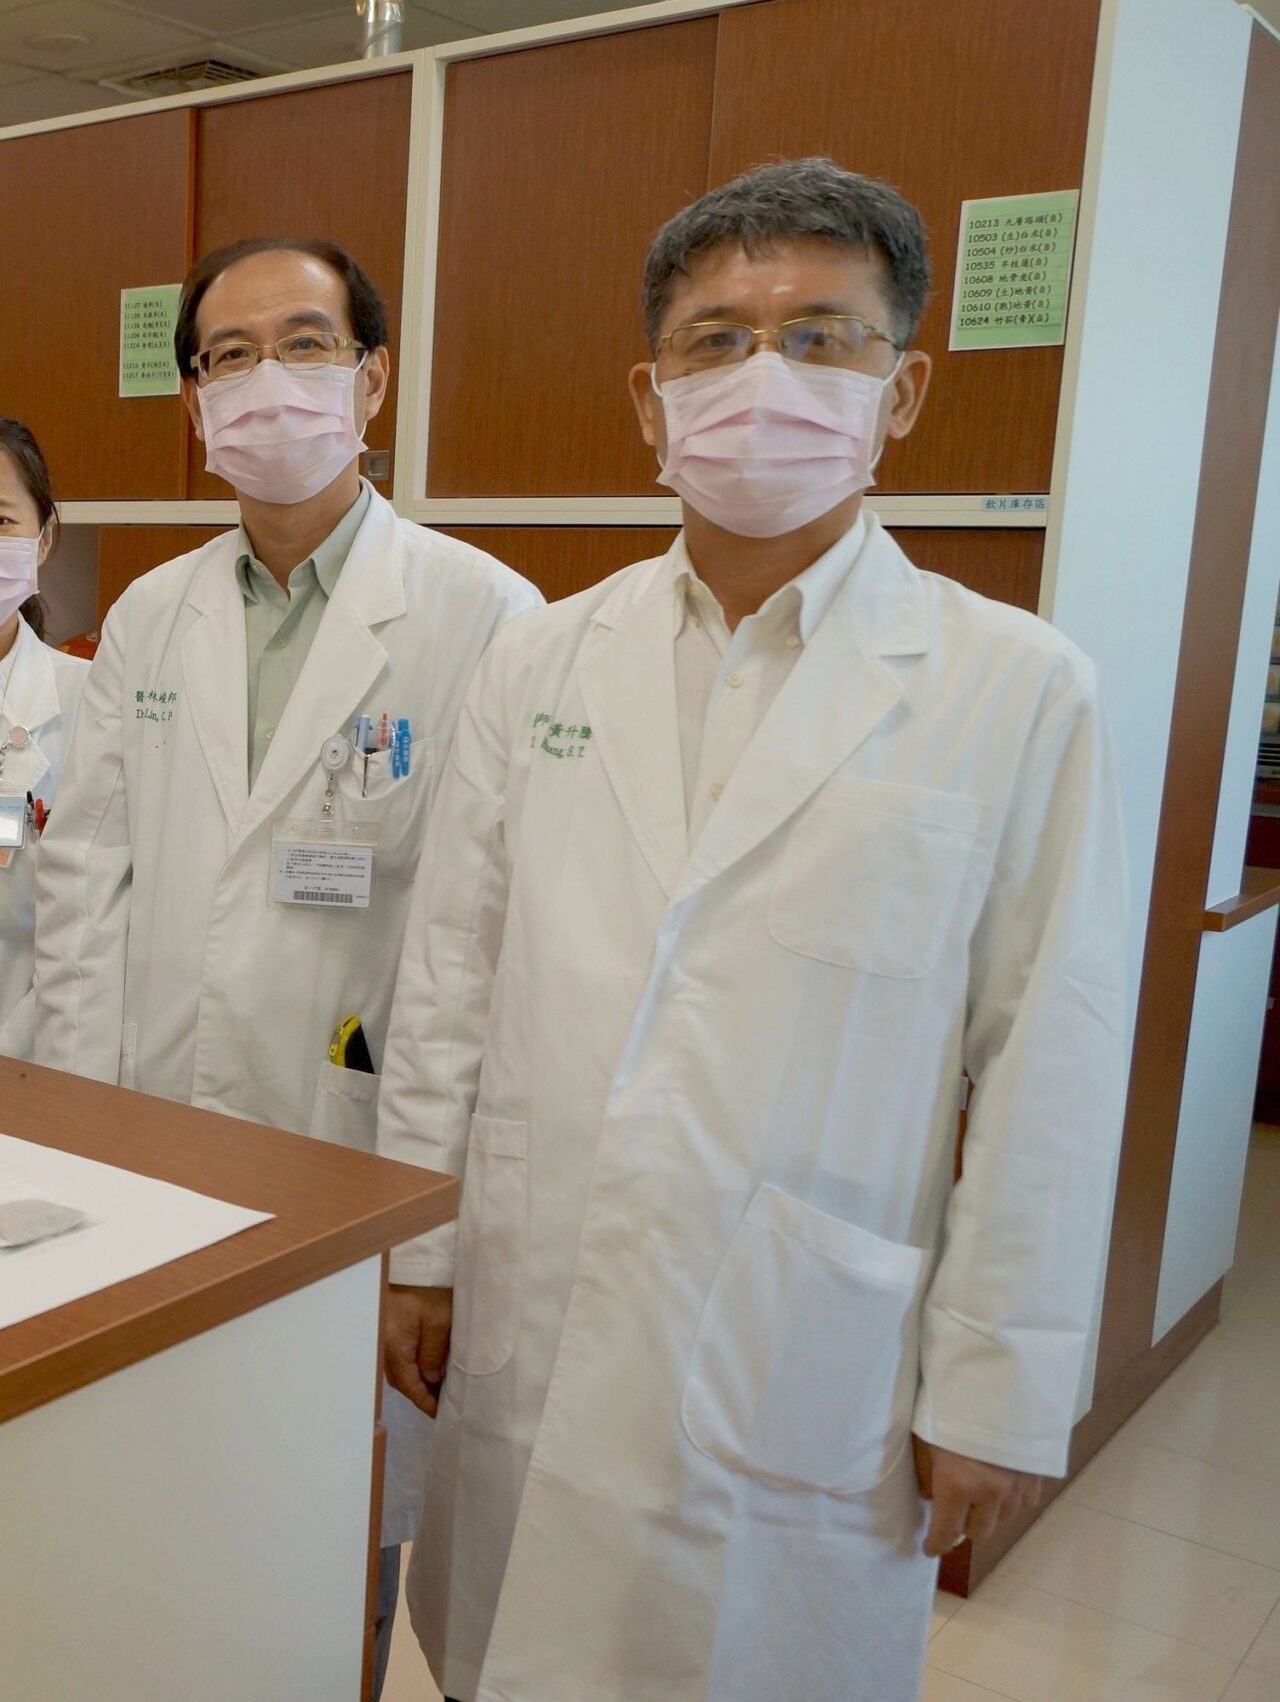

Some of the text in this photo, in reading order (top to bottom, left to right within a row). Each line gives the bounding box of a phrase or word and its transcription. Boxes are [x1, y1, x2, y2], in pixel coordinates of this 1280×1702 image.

[969, 218, 1000, 230] 10213
[968, 232, 998, 244] 10503
[967, 246, 997, 257] 10504
[965, 260, 995, 271] 10535
[964, 274, 994, 285] 10608
[962, 288, 992, 299] 10609
[961, 302, 991, 313] 10610
[959, 316, 990, 327] 10624
